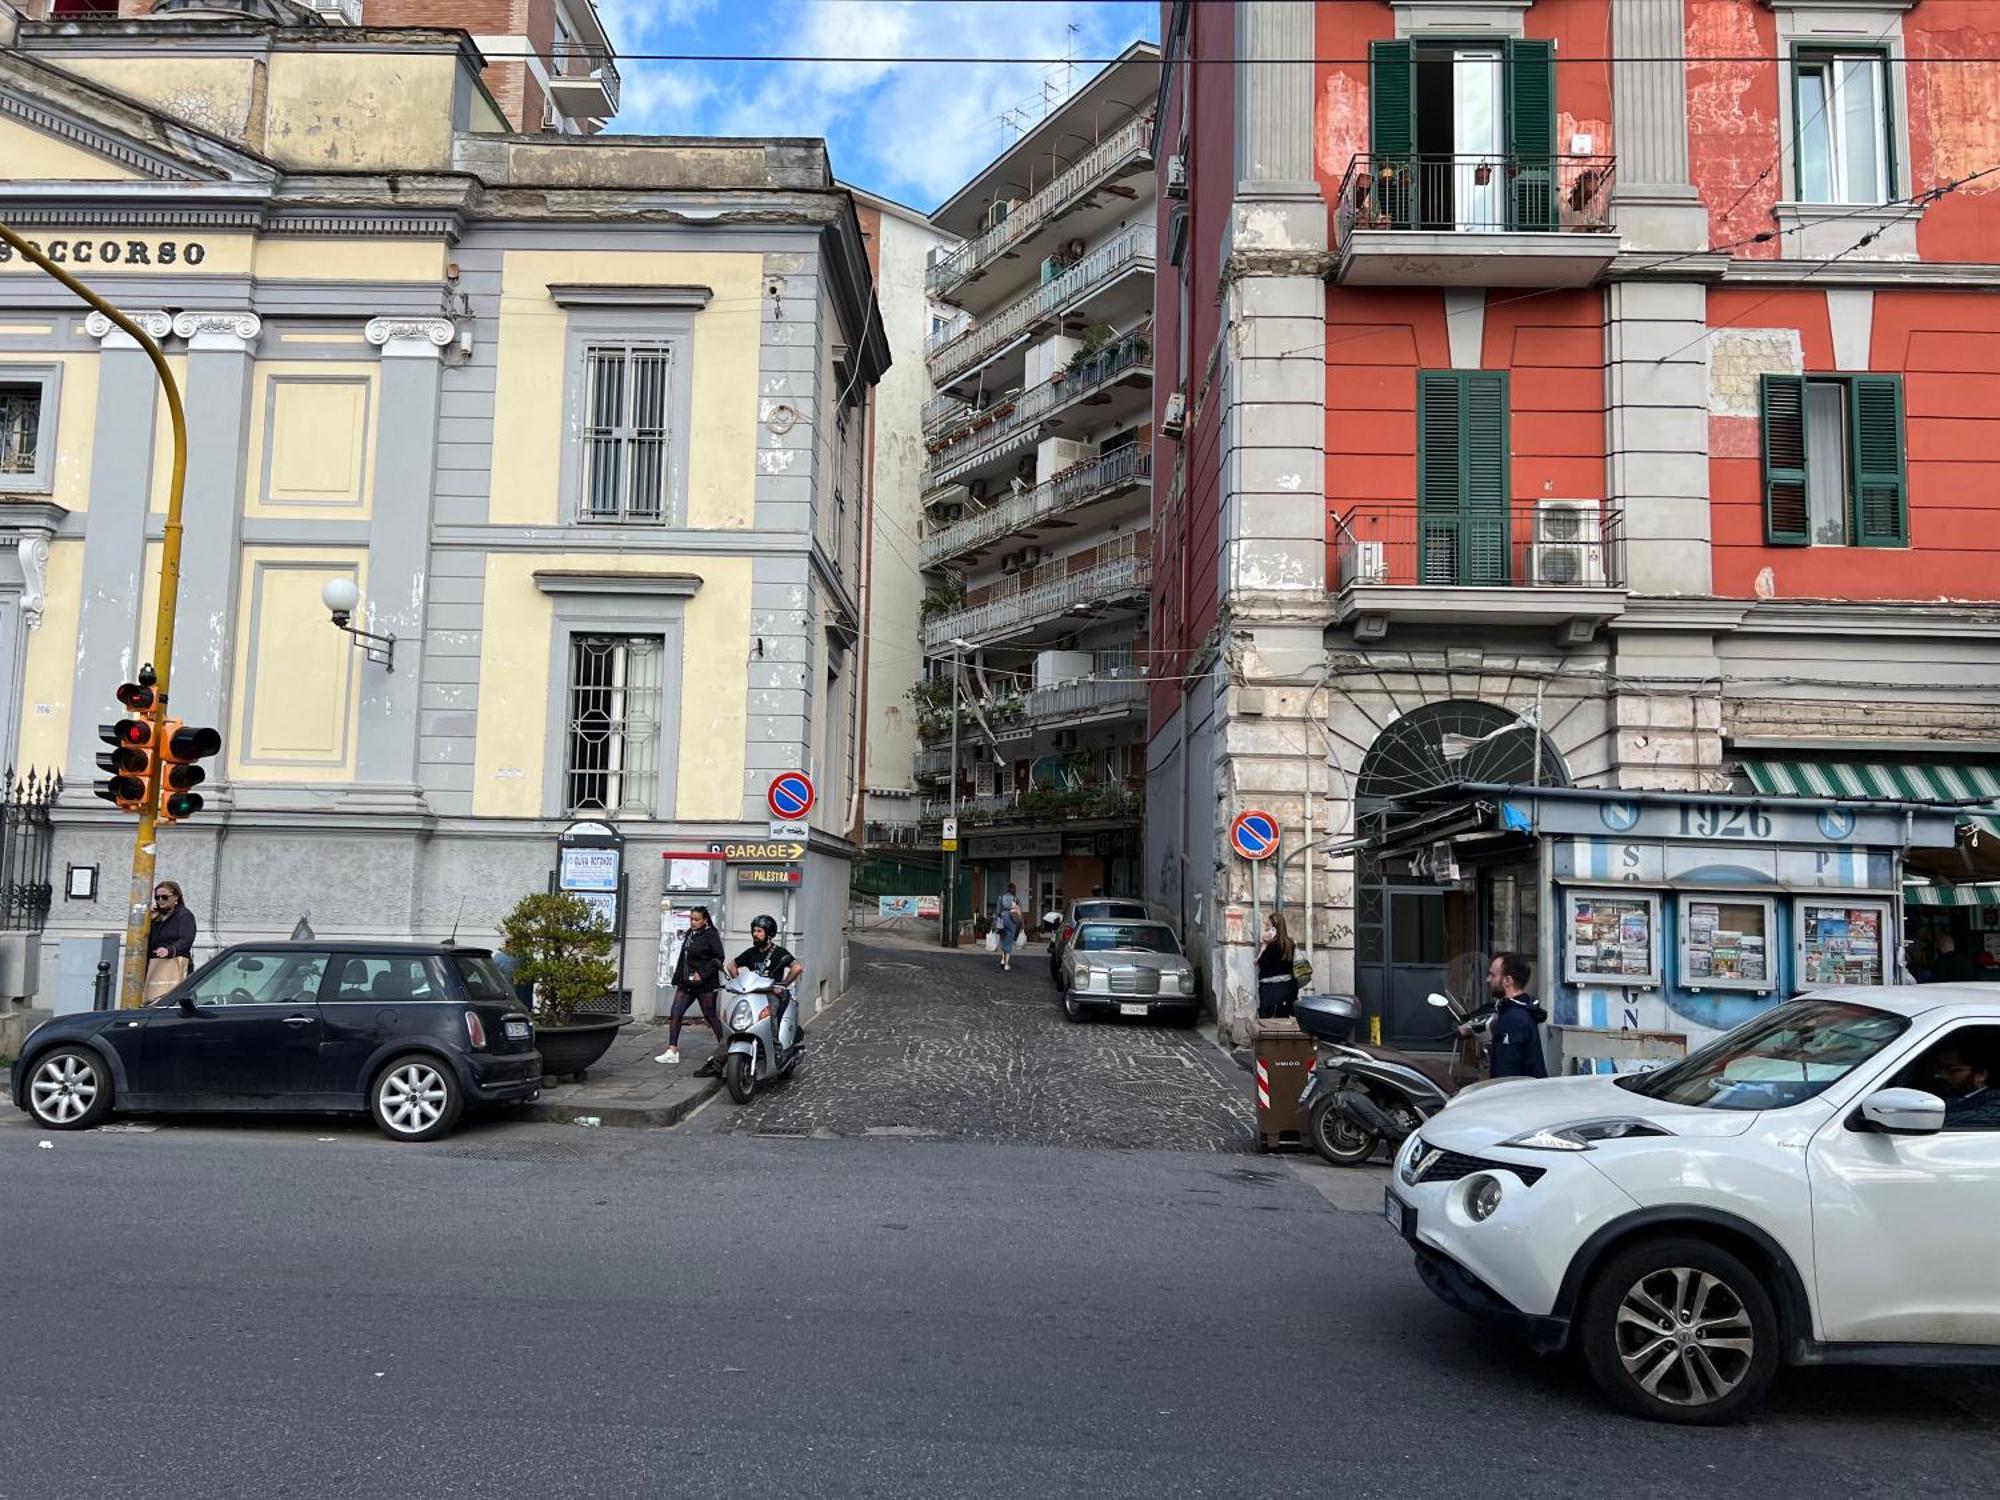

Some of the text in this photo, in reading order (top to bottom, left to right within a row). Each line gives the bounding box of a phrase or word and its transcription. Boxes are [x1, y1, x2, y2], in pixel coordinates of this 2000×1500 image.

[1680, 803, 1772, 838] 1926
[725, 844, 788, 858] GARAGE
[754, 871, 789, 882] PALESTRA
